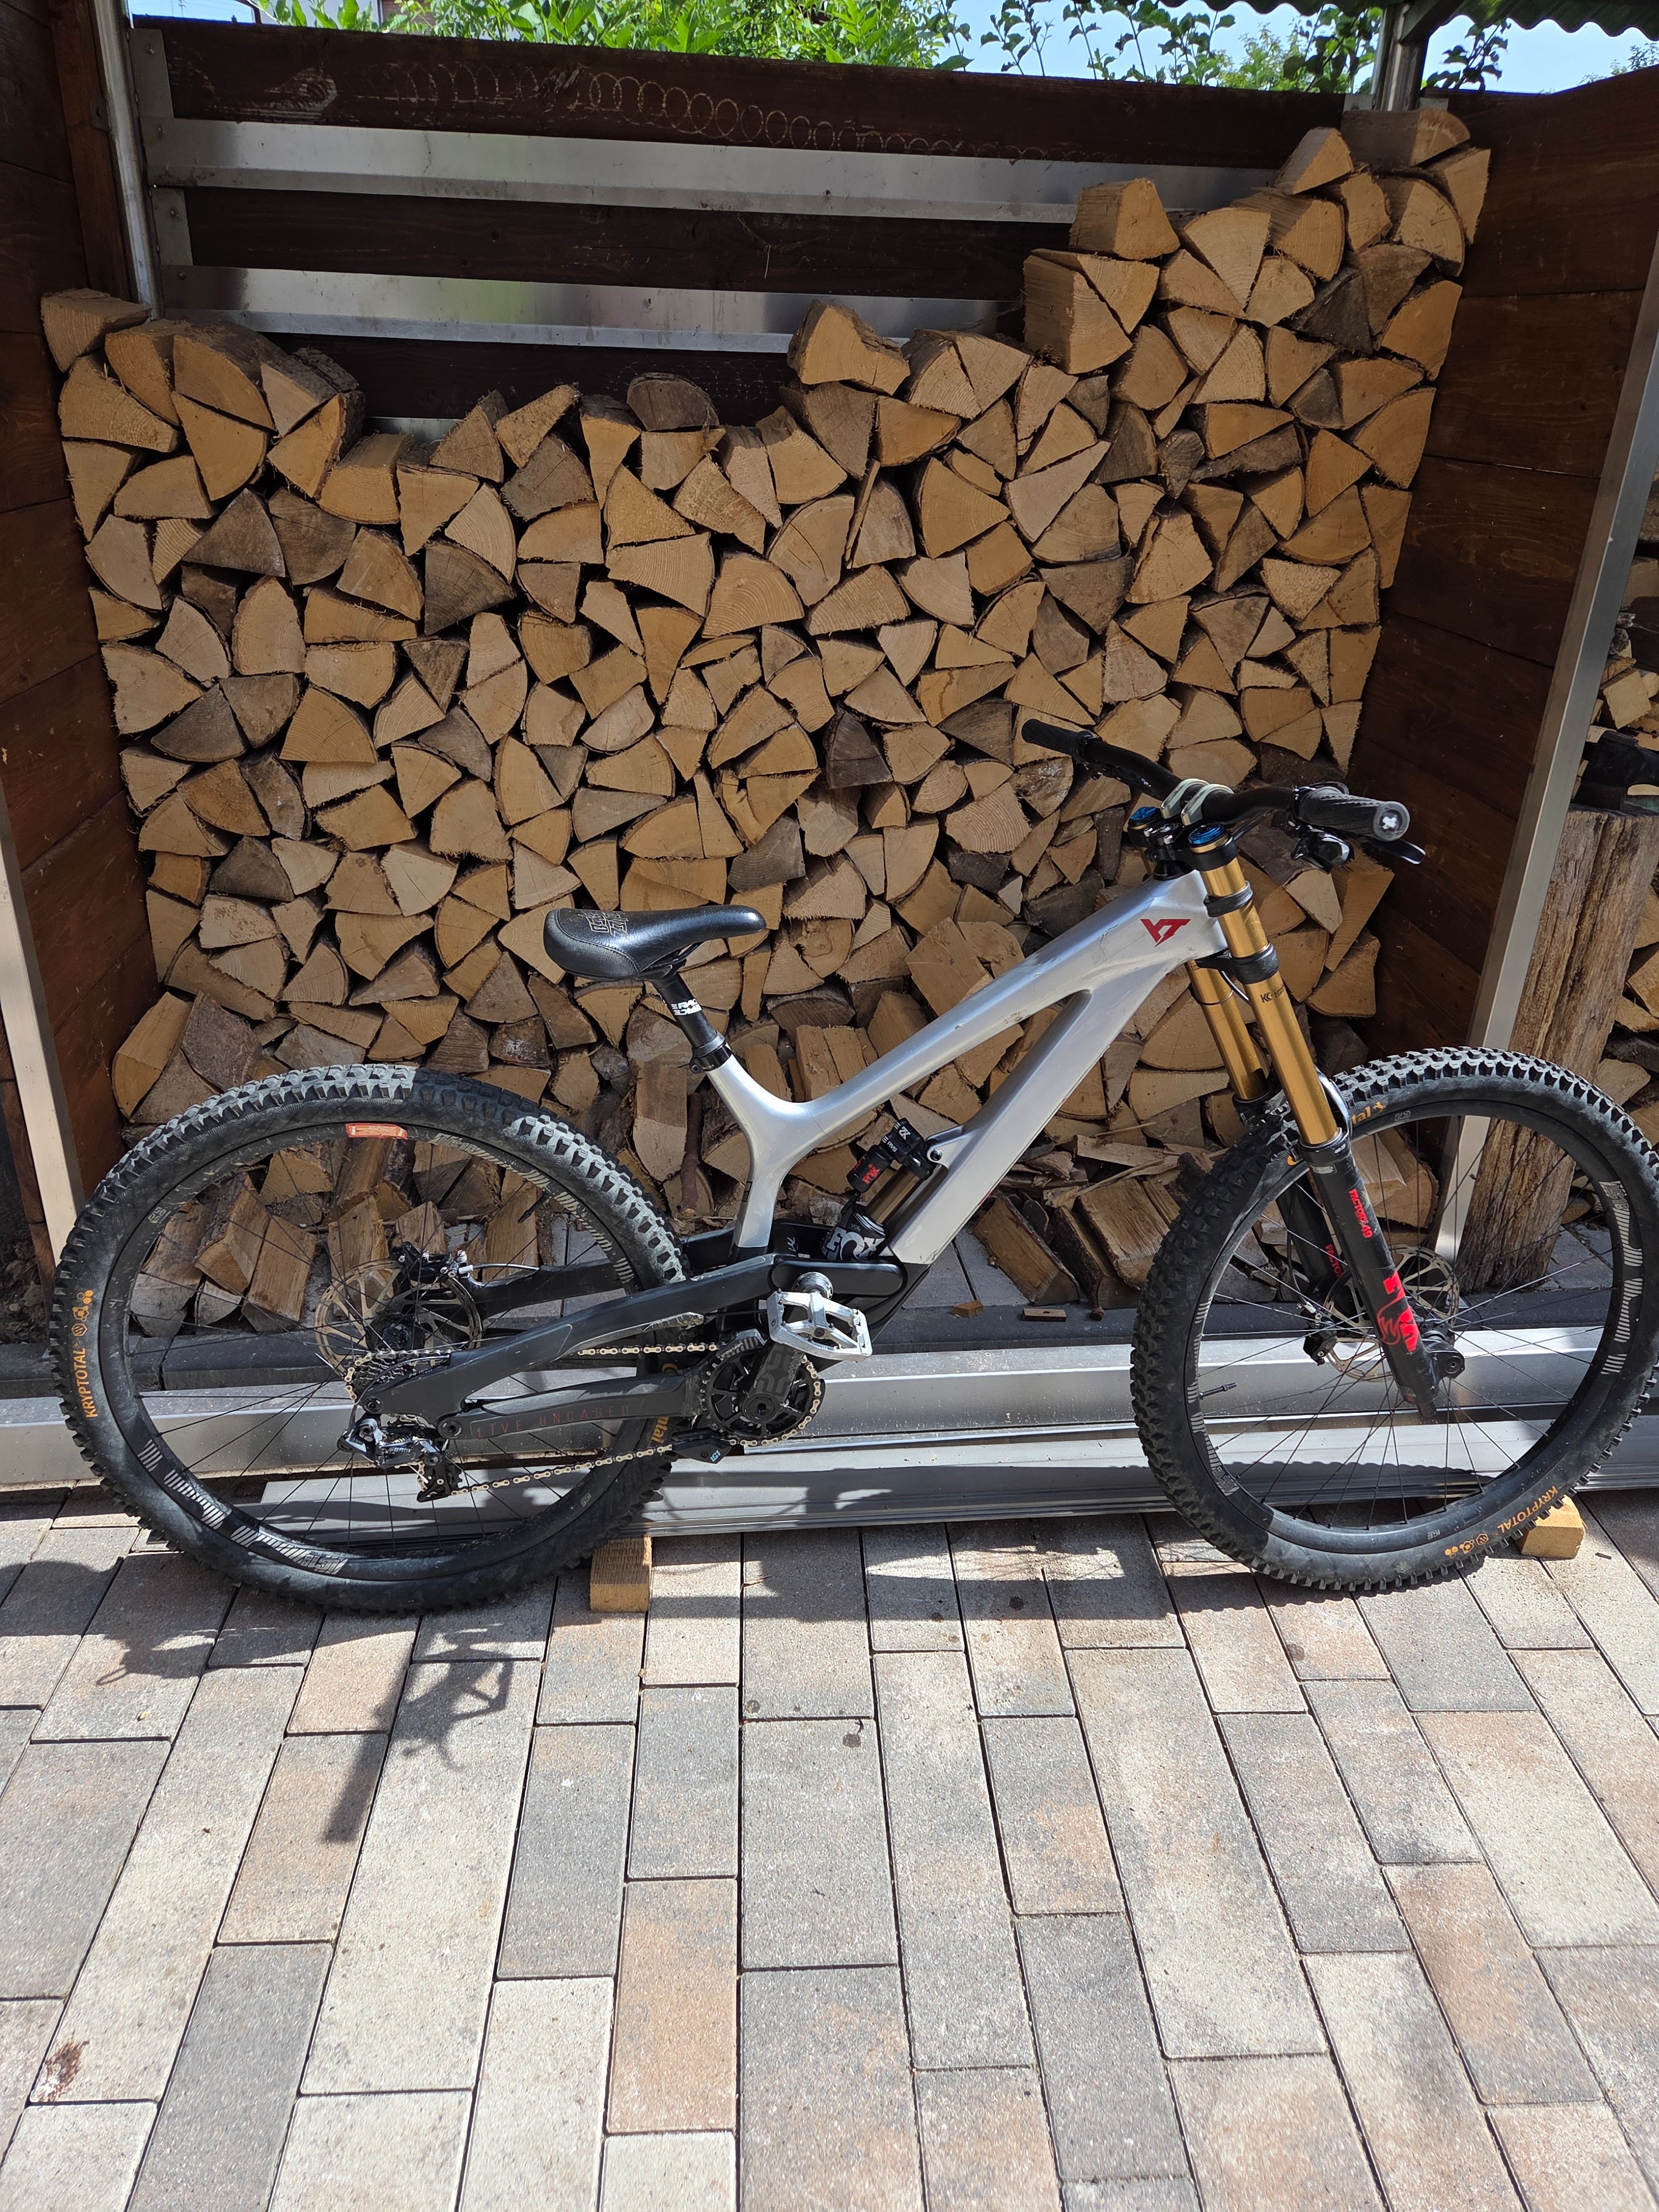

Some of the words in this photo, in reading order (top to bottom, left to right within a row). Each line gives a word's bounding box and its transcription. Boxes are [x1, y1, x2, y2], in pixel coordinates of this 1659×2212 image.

[1140, 919, 1191, 948] YT
[73, 1348, 98, 1418] KRYPTOTAL
[539, 1405, 629, 1426] UNCAGED
[1497, 1485, 1558, 1533] KRYPTOTAL
